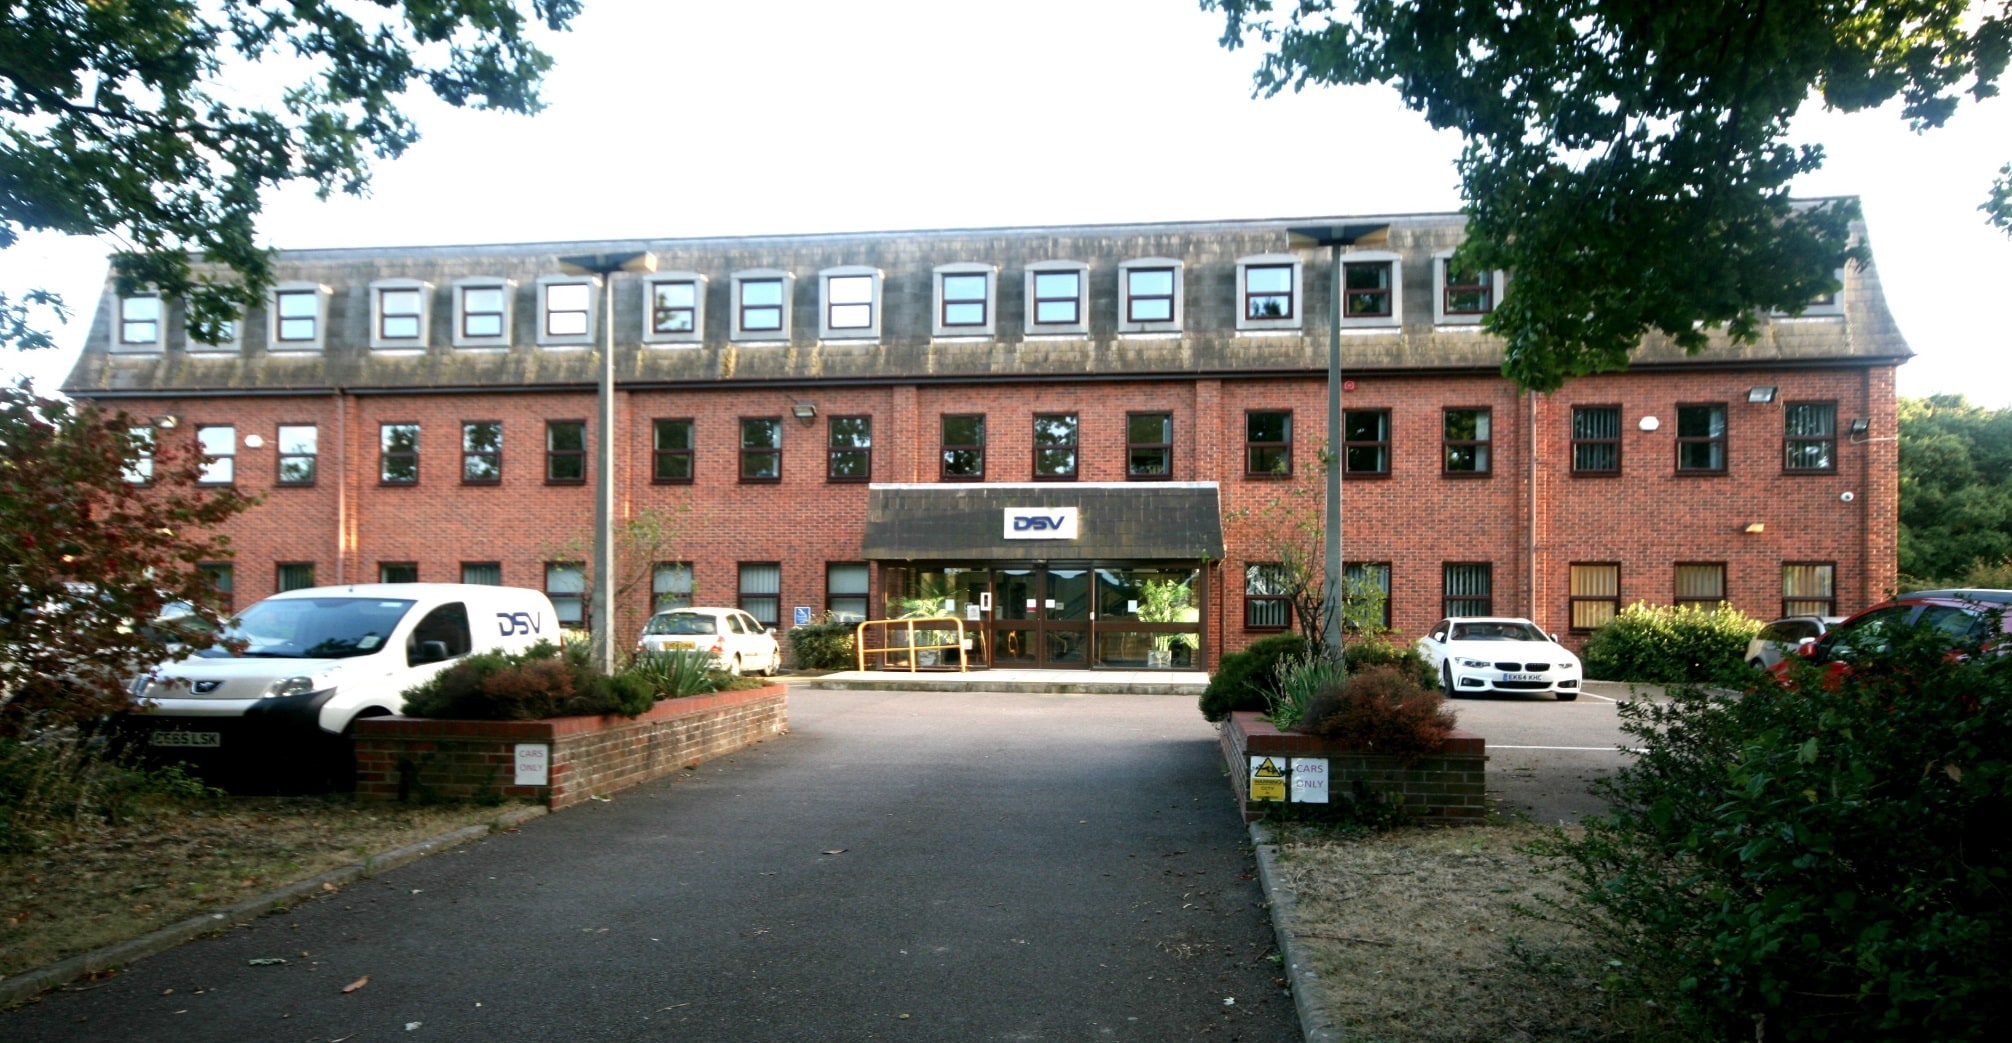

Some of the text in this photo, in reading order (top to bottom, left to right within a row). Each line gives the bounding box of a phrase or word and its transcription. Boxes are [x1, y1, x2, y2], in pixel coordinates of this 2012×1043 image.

[1014, 516, 1065, 531] DSV
[496, 611, 541, 636] DSV
[191, 733, 217, 745] LSK
[519, 749, 544, 758] CARS
[519, 763, 543, 772] ONLY
[1296, 764, 1324, 773] CARS
[1296, 779, 1324, 788] ONLY
